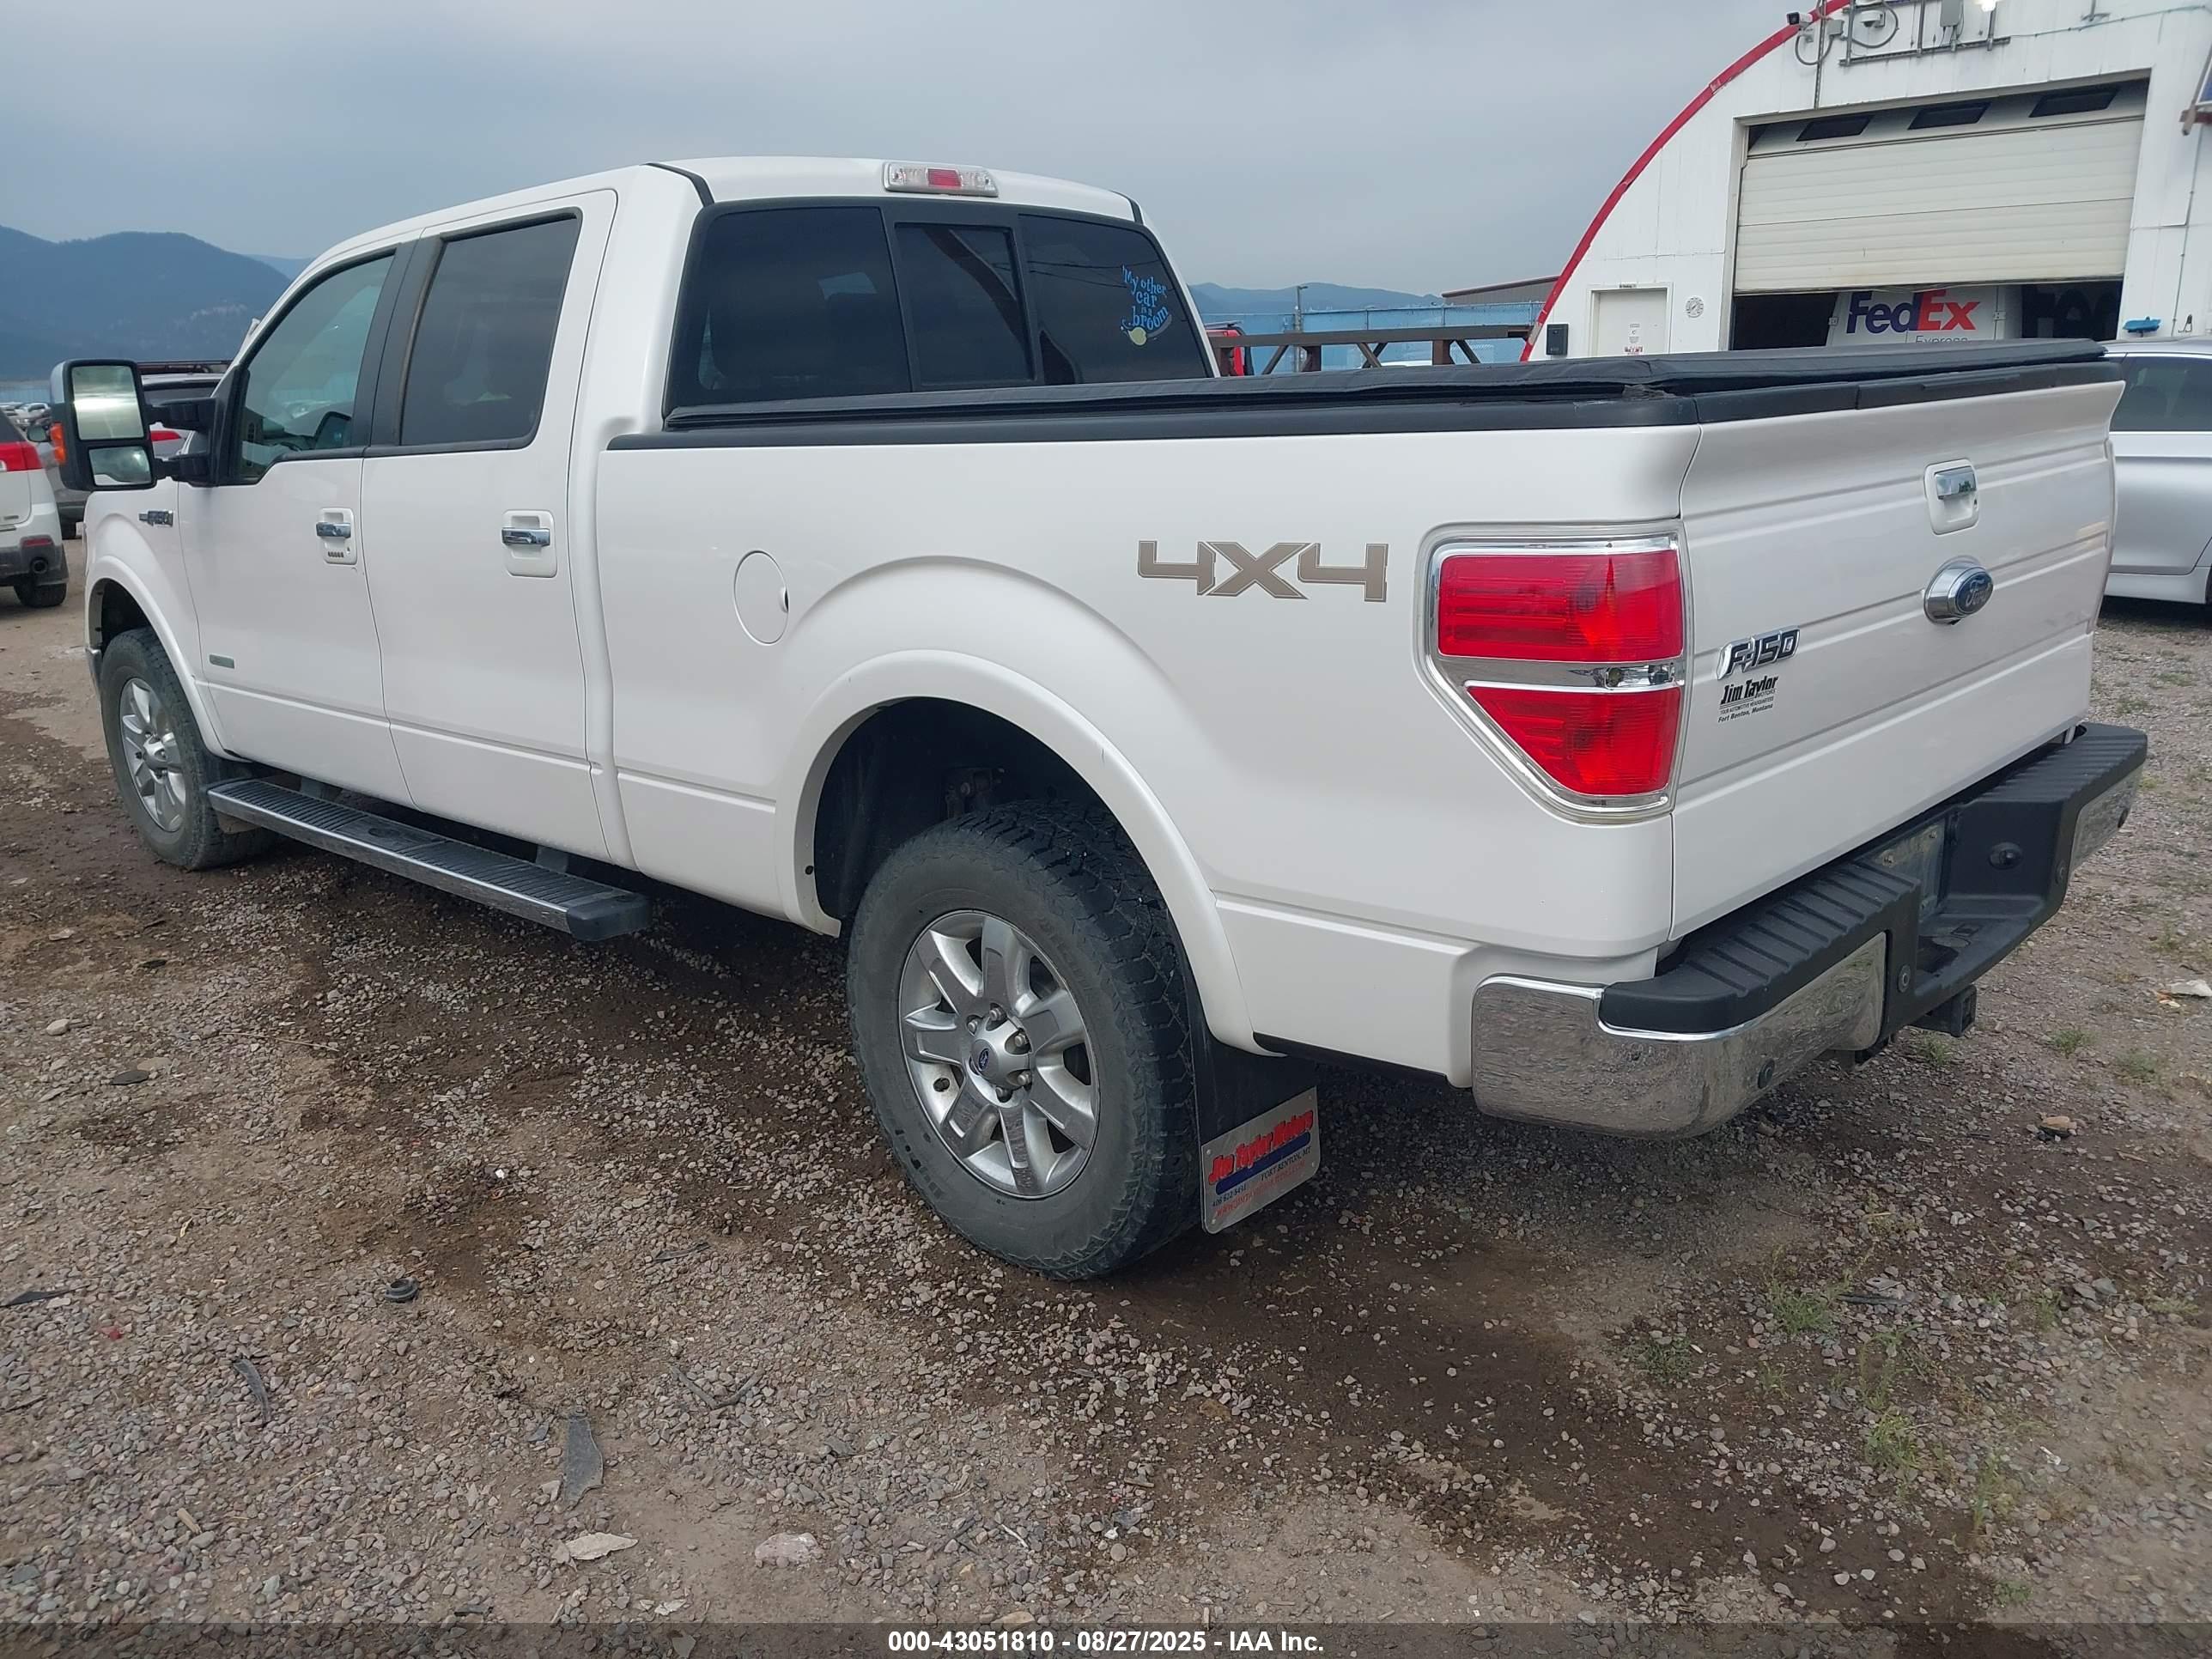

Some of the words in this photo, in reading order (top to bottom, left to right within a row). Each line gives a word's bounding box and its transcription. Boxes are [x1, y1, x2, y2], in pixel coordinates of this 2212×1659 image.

[1136, 291, 1158, 307] car
[1140, 276, 1167, 298] other
[1132, 306, 1169, 331] broom
[1846, 289, 1980, 334] FedEx
[1717, 625, 1800, 680] F-150
[1720, 684, 1743, 705] Jim
[1743, 675, 1779, 698] Taylor
[1751, 703, 1773, 714] Montana
[1208, 1154, 1235, 1185] Jim
[1236, 1132, 1274, 1169] Taylor
